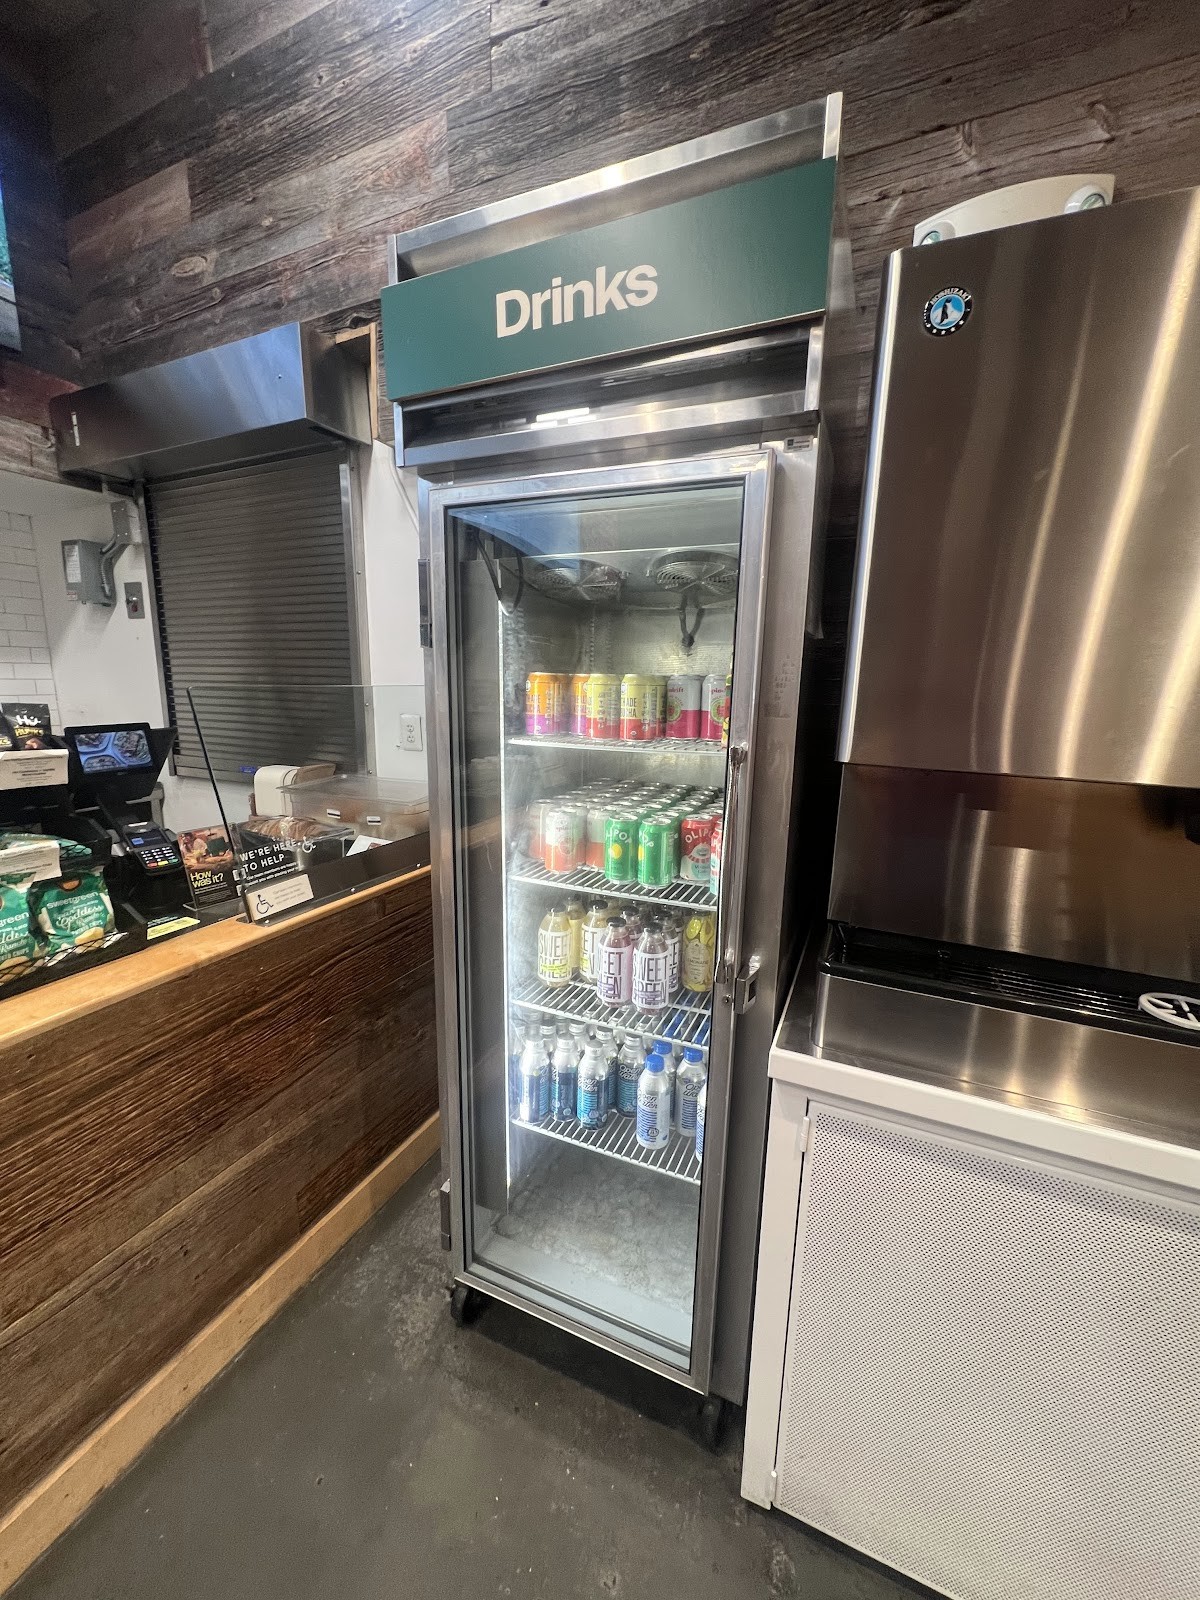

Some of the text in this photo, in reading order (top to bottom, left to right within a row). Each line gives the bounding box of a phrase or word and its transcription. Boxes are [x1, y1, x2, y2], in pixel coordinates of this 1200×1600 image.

[496, 265, 658, 338] Drinks
[239, 846, 271, 862] WE'RE
[243, 862, 258, 873] TO
[261, 853, 285, 867] HELP
[190, 870, 212, 881] How
[192, 873, 224, 888] was it?
[47, 891, 99, 909] sweetgreen
